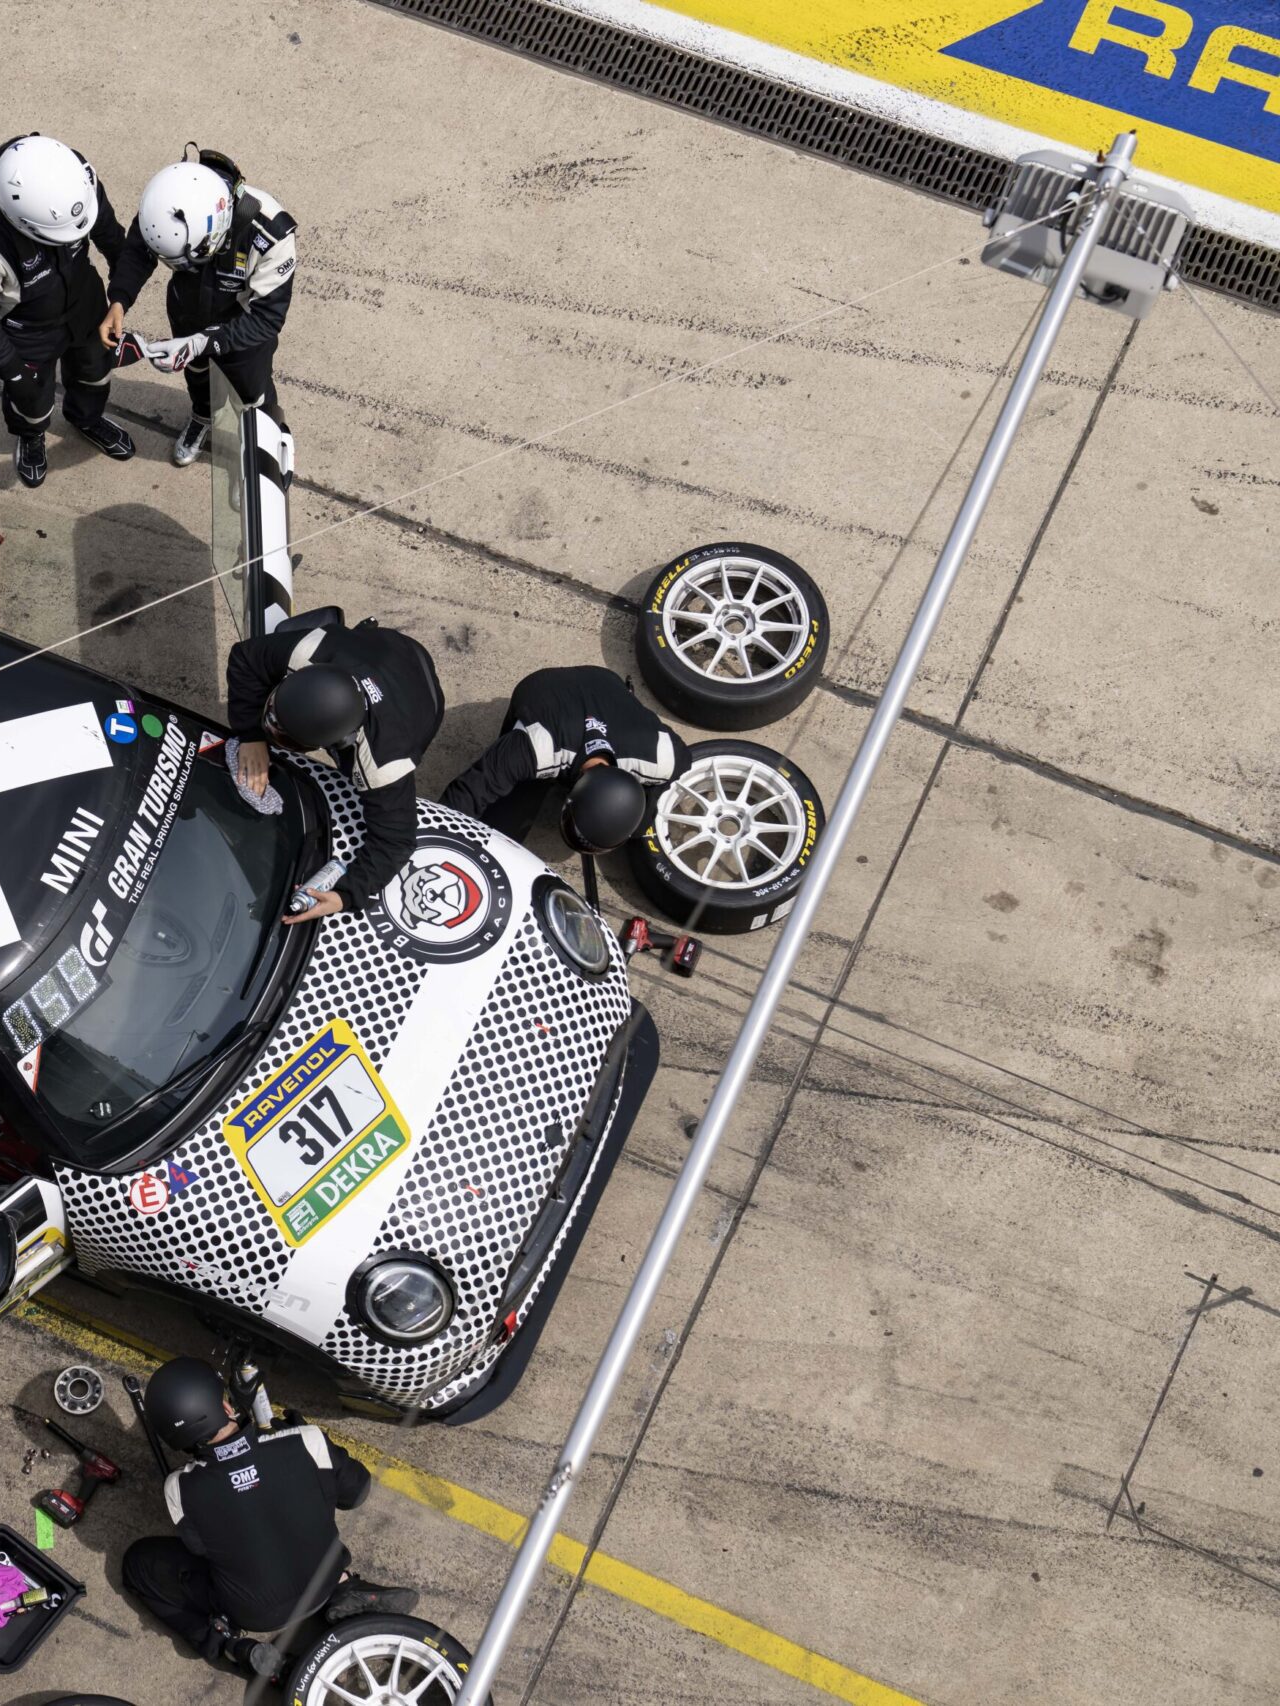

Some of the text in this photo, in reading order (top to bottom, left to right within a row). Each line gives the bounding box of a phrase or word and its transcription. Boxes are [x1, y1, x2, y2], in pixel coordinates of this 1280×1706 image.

[254, 235, 270, 251] OMP
[277, 258, 295, 275] OMP
[652, 558, 690, 614] PIRELLI
[784, 635, 817, 680] ZERO
[110, 717, 135, 735] T
[40, 807, 105, 894] MINI
[129, 741, 197, 904] THE REAL DRIVING SIMULATOR
[798, 799, 818, 866] PIRELLI
[107, 821, 152, 899] GRAN
[368, 892, 410, 949] BULL
[479, 853, 507, 942] RACING
[243, 1047, 336, 1128] RAVENOL
[279, 1085, 353, 1166] 317
[138, 1182, 160, 1208] E
[314, 1131, 400, 1208] DEKRA
[230, 1467, 258, 1486] OMP
